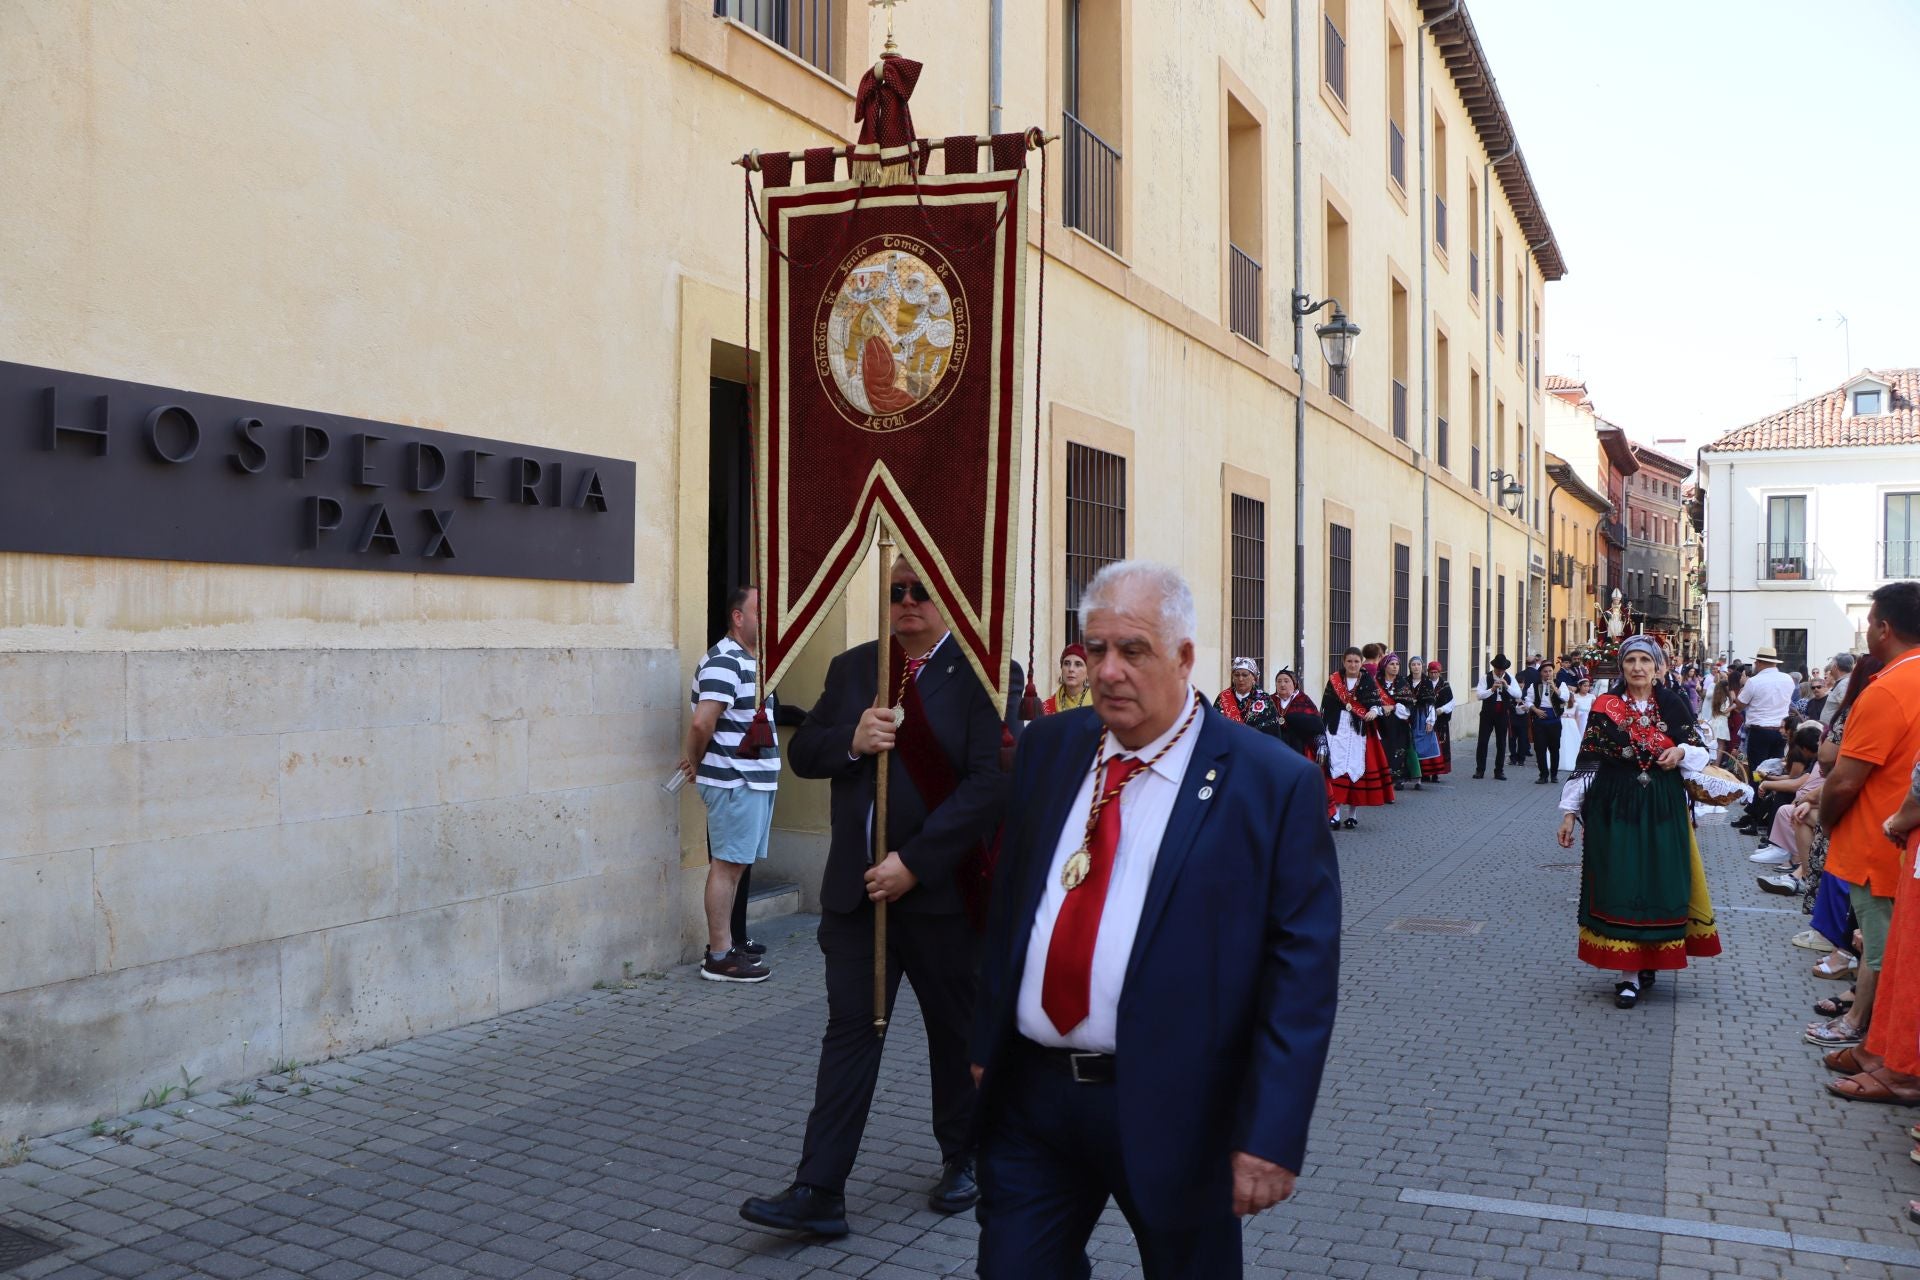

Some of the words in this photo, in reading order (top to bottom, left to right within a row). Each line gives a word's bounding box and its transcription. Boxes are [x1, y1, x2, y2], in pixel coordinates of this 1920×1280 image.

[825, 290, 836, 304] de
[839, 246, 868, 276] Santo
[882, 236, 925, 255] Tomas
[936, 263, 949, 278] de
[949, 297, 966, 372] Canterbury
[43, 385, 608, 513] HOSPEDERIA
[304, 494, 456, 559] PAX
